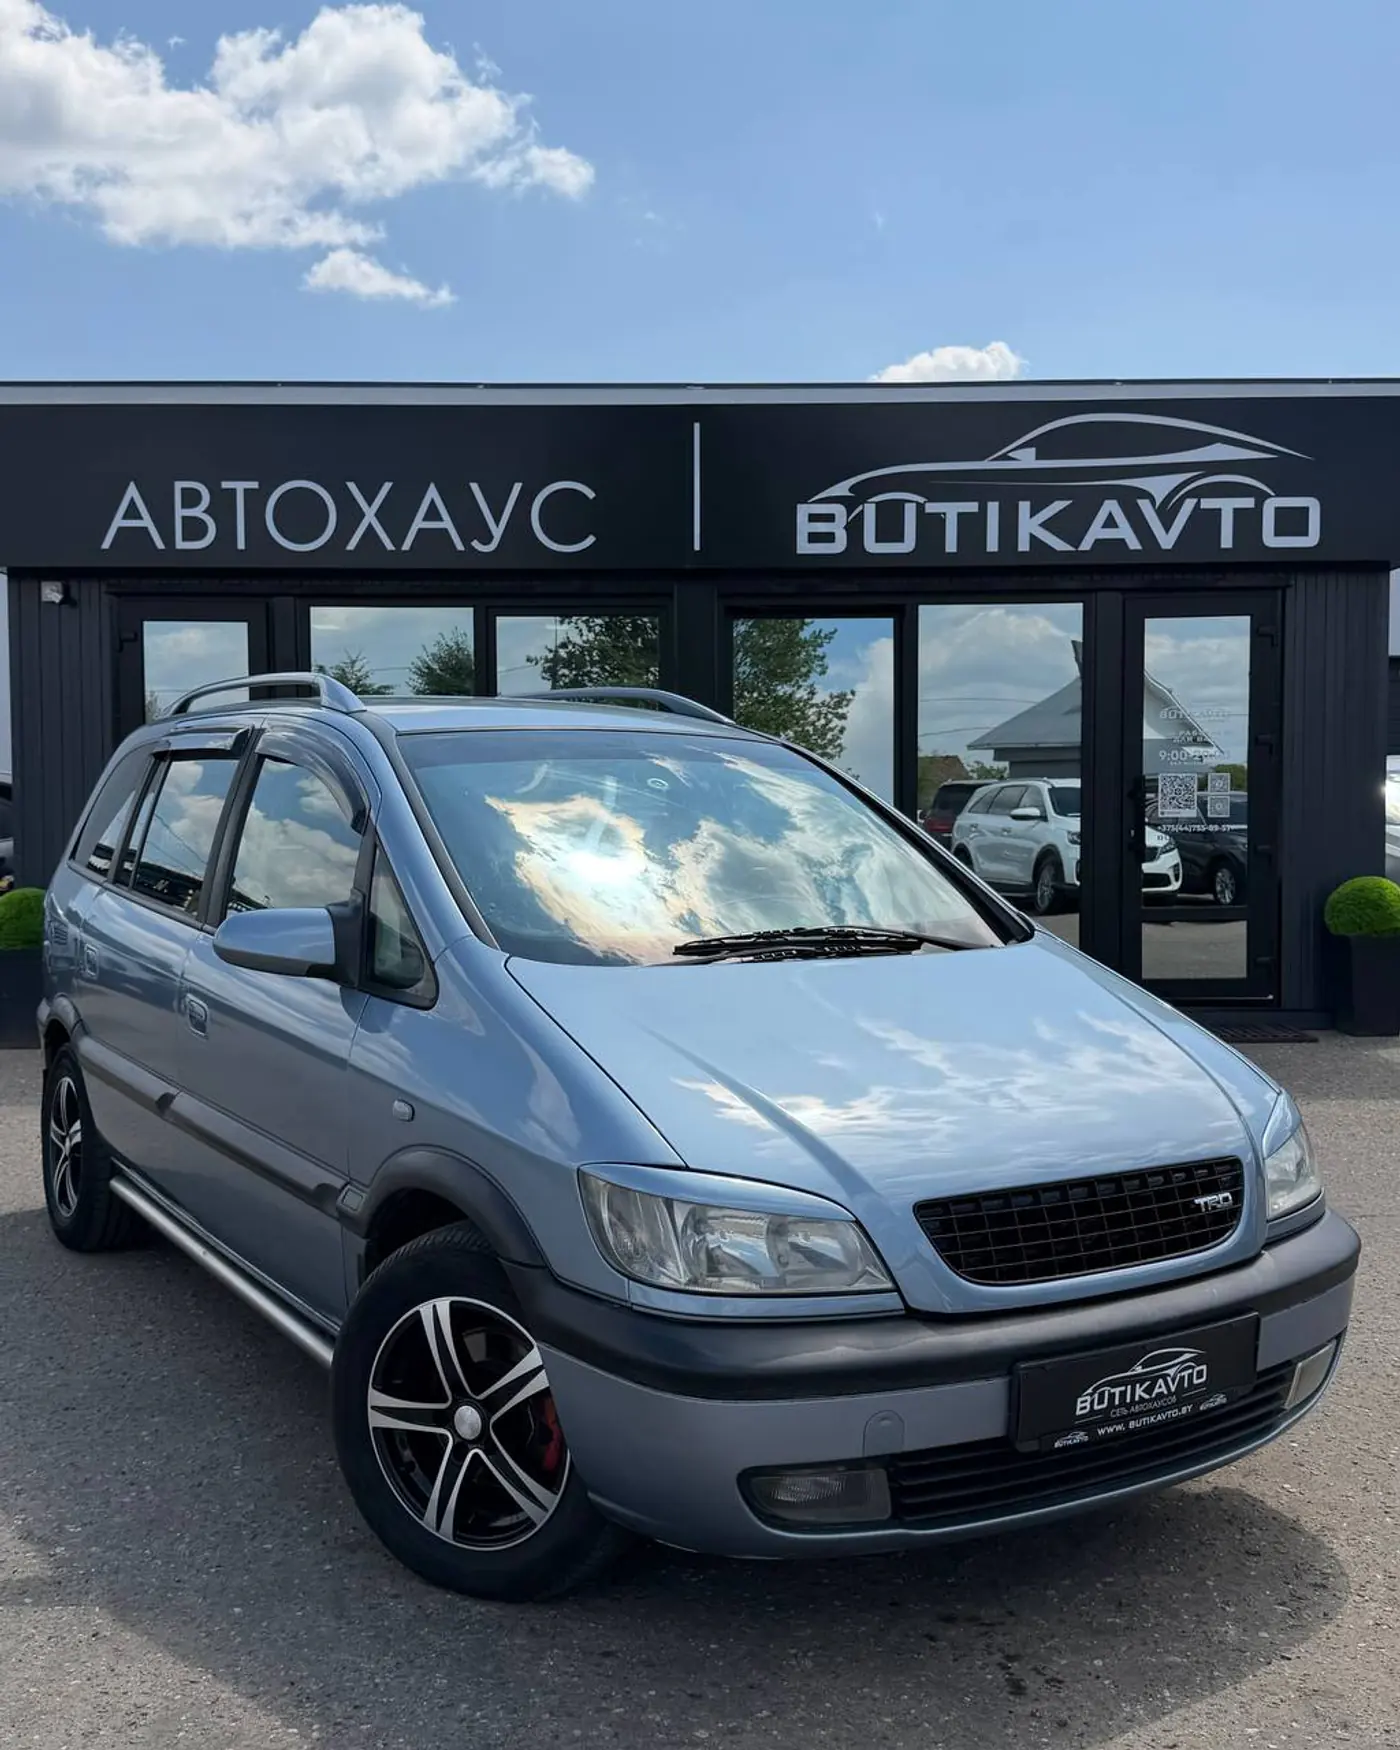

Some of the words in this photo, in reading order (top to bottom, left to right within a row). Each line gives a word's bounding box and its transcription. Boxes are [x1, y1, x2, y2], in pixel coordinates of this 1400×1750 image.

[101, 479, 597, 553] АВТОХАУС
[796, 496, 1321, 556] BUTIKAVTO
[1075, 1364, 1208, 1416] BUTIKAVTO
